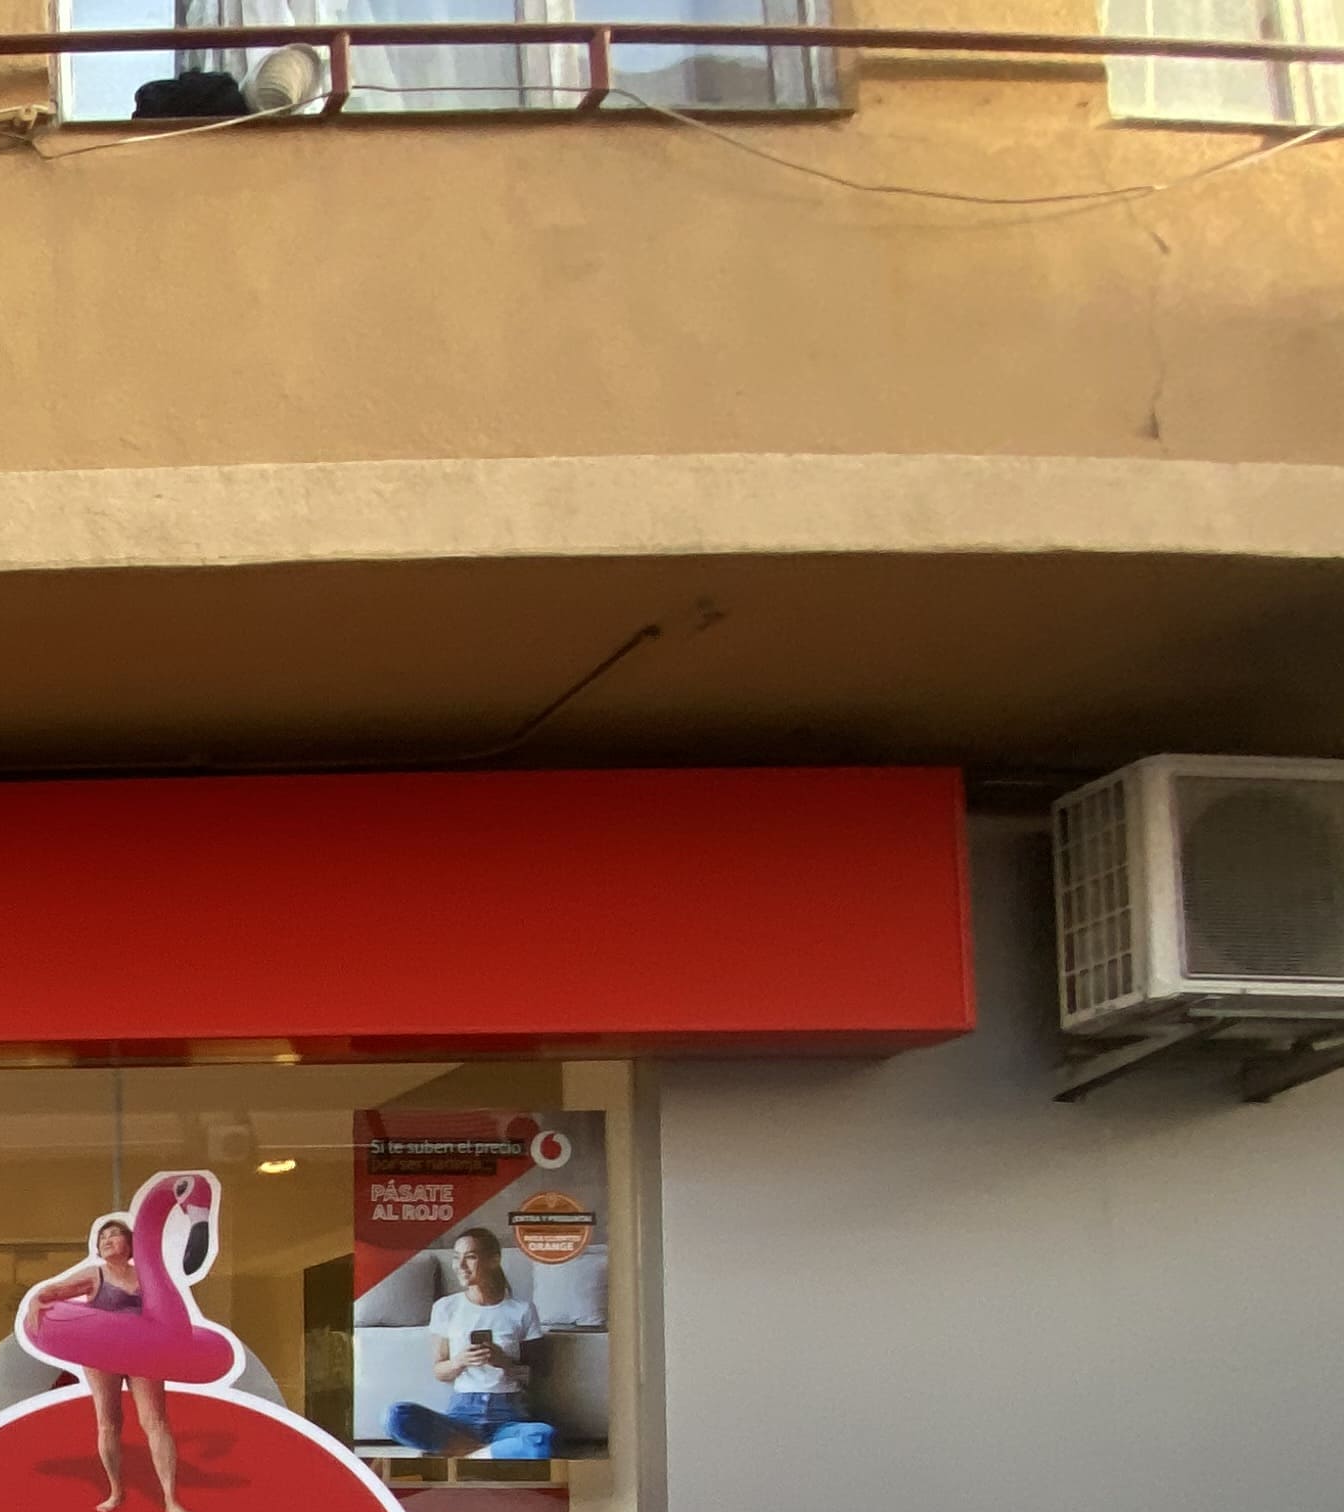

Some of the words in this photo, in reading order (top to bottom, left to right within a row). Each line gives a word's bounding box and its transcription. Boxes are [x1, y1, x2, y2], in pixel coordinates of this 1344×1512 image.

[371, 1179, 454, 1203] PÁSATE
[372, 1204, 399, 1221] AL
[402, 1204, 453, 1221] ROJO
